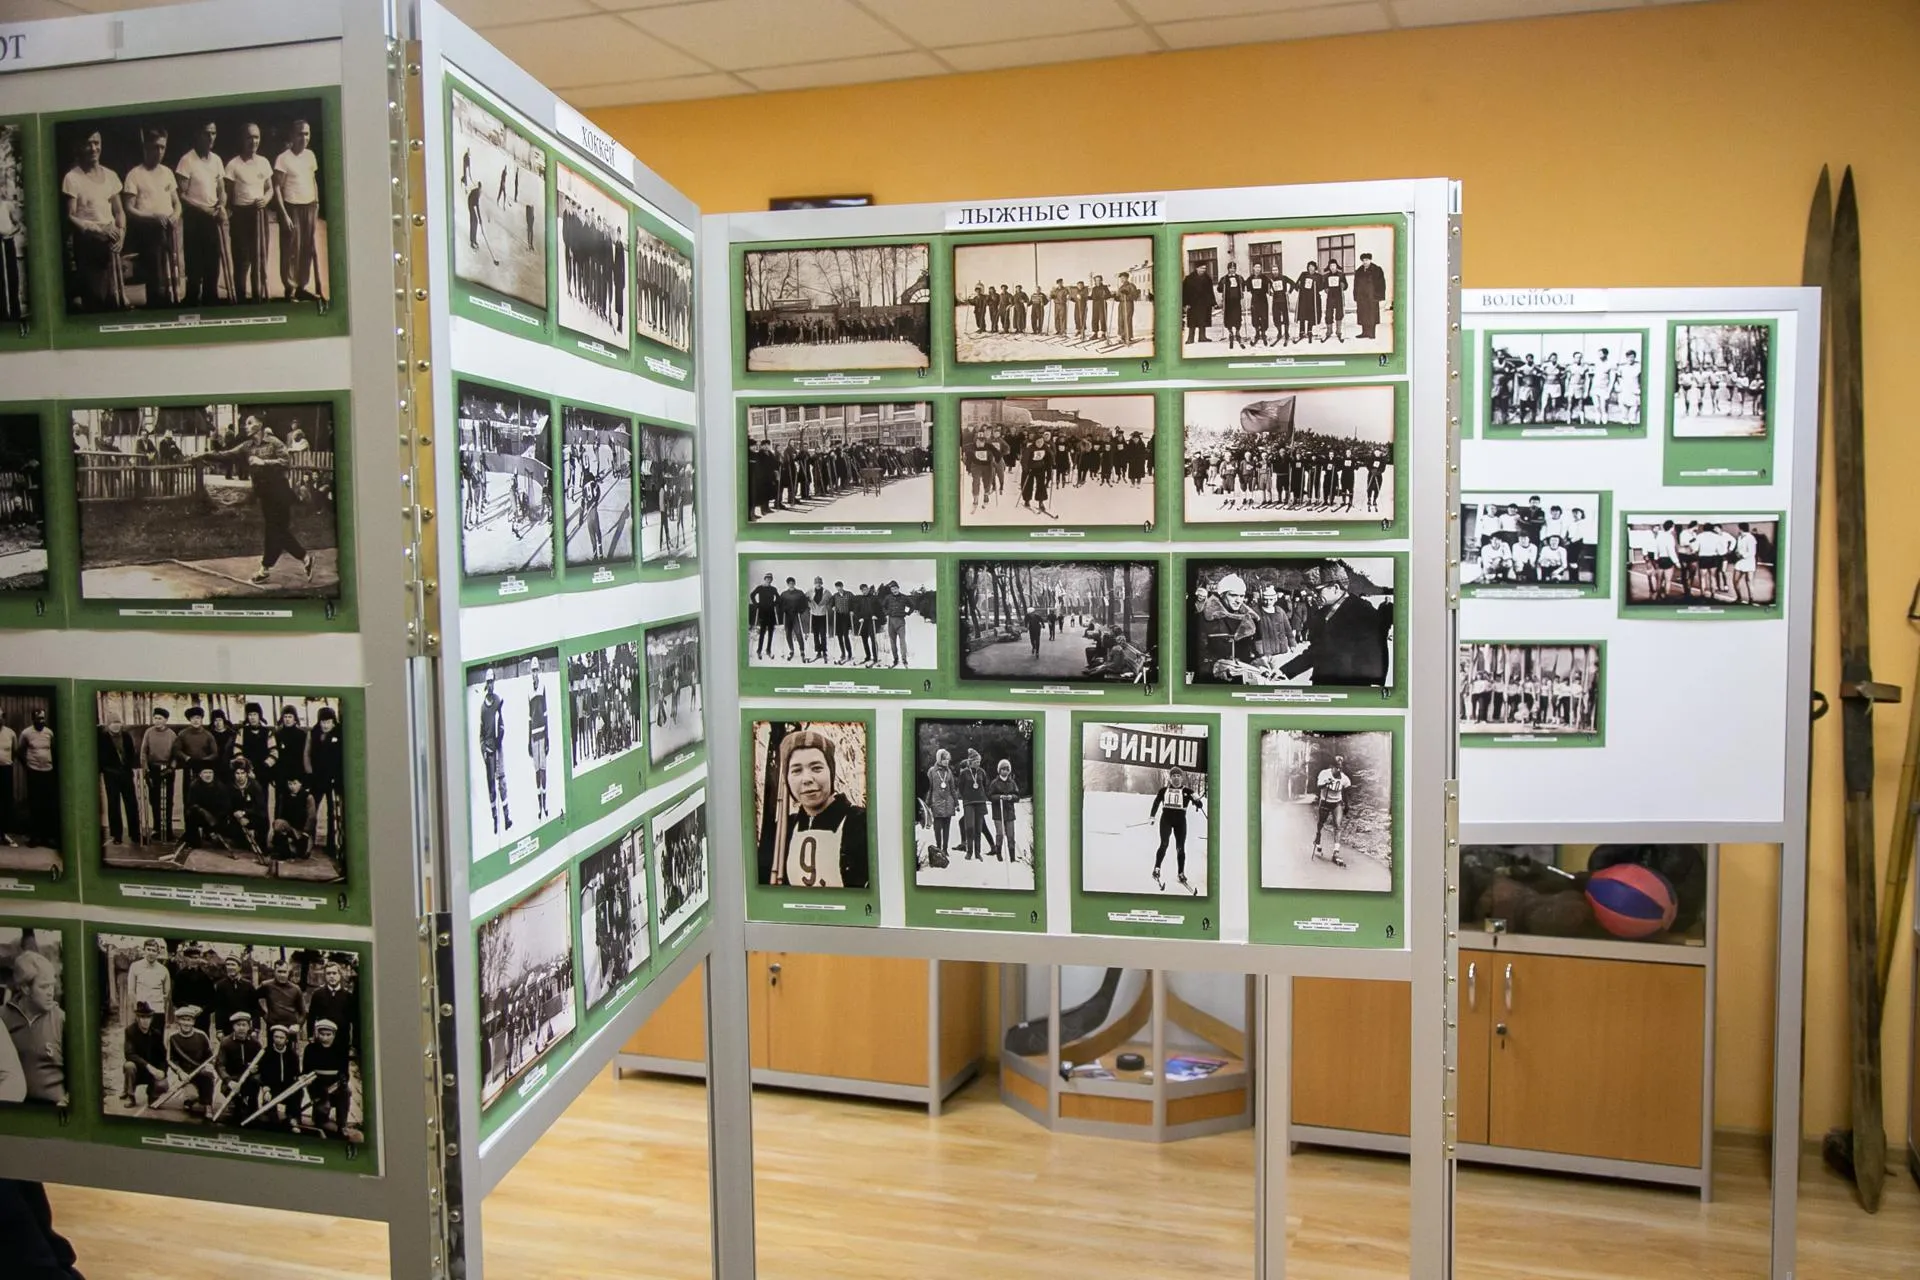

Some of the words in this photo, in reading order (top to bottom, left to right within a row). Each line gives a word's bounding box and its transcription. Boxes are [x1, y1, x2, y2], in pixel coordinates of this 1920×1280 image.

[581, 125, 616, 167] хоккей
[958, 203, 1070, 225] лыжные
[1079, 199, 1159, 220] гонки
[1100, 730, 1199, 768] ФИНИШ
